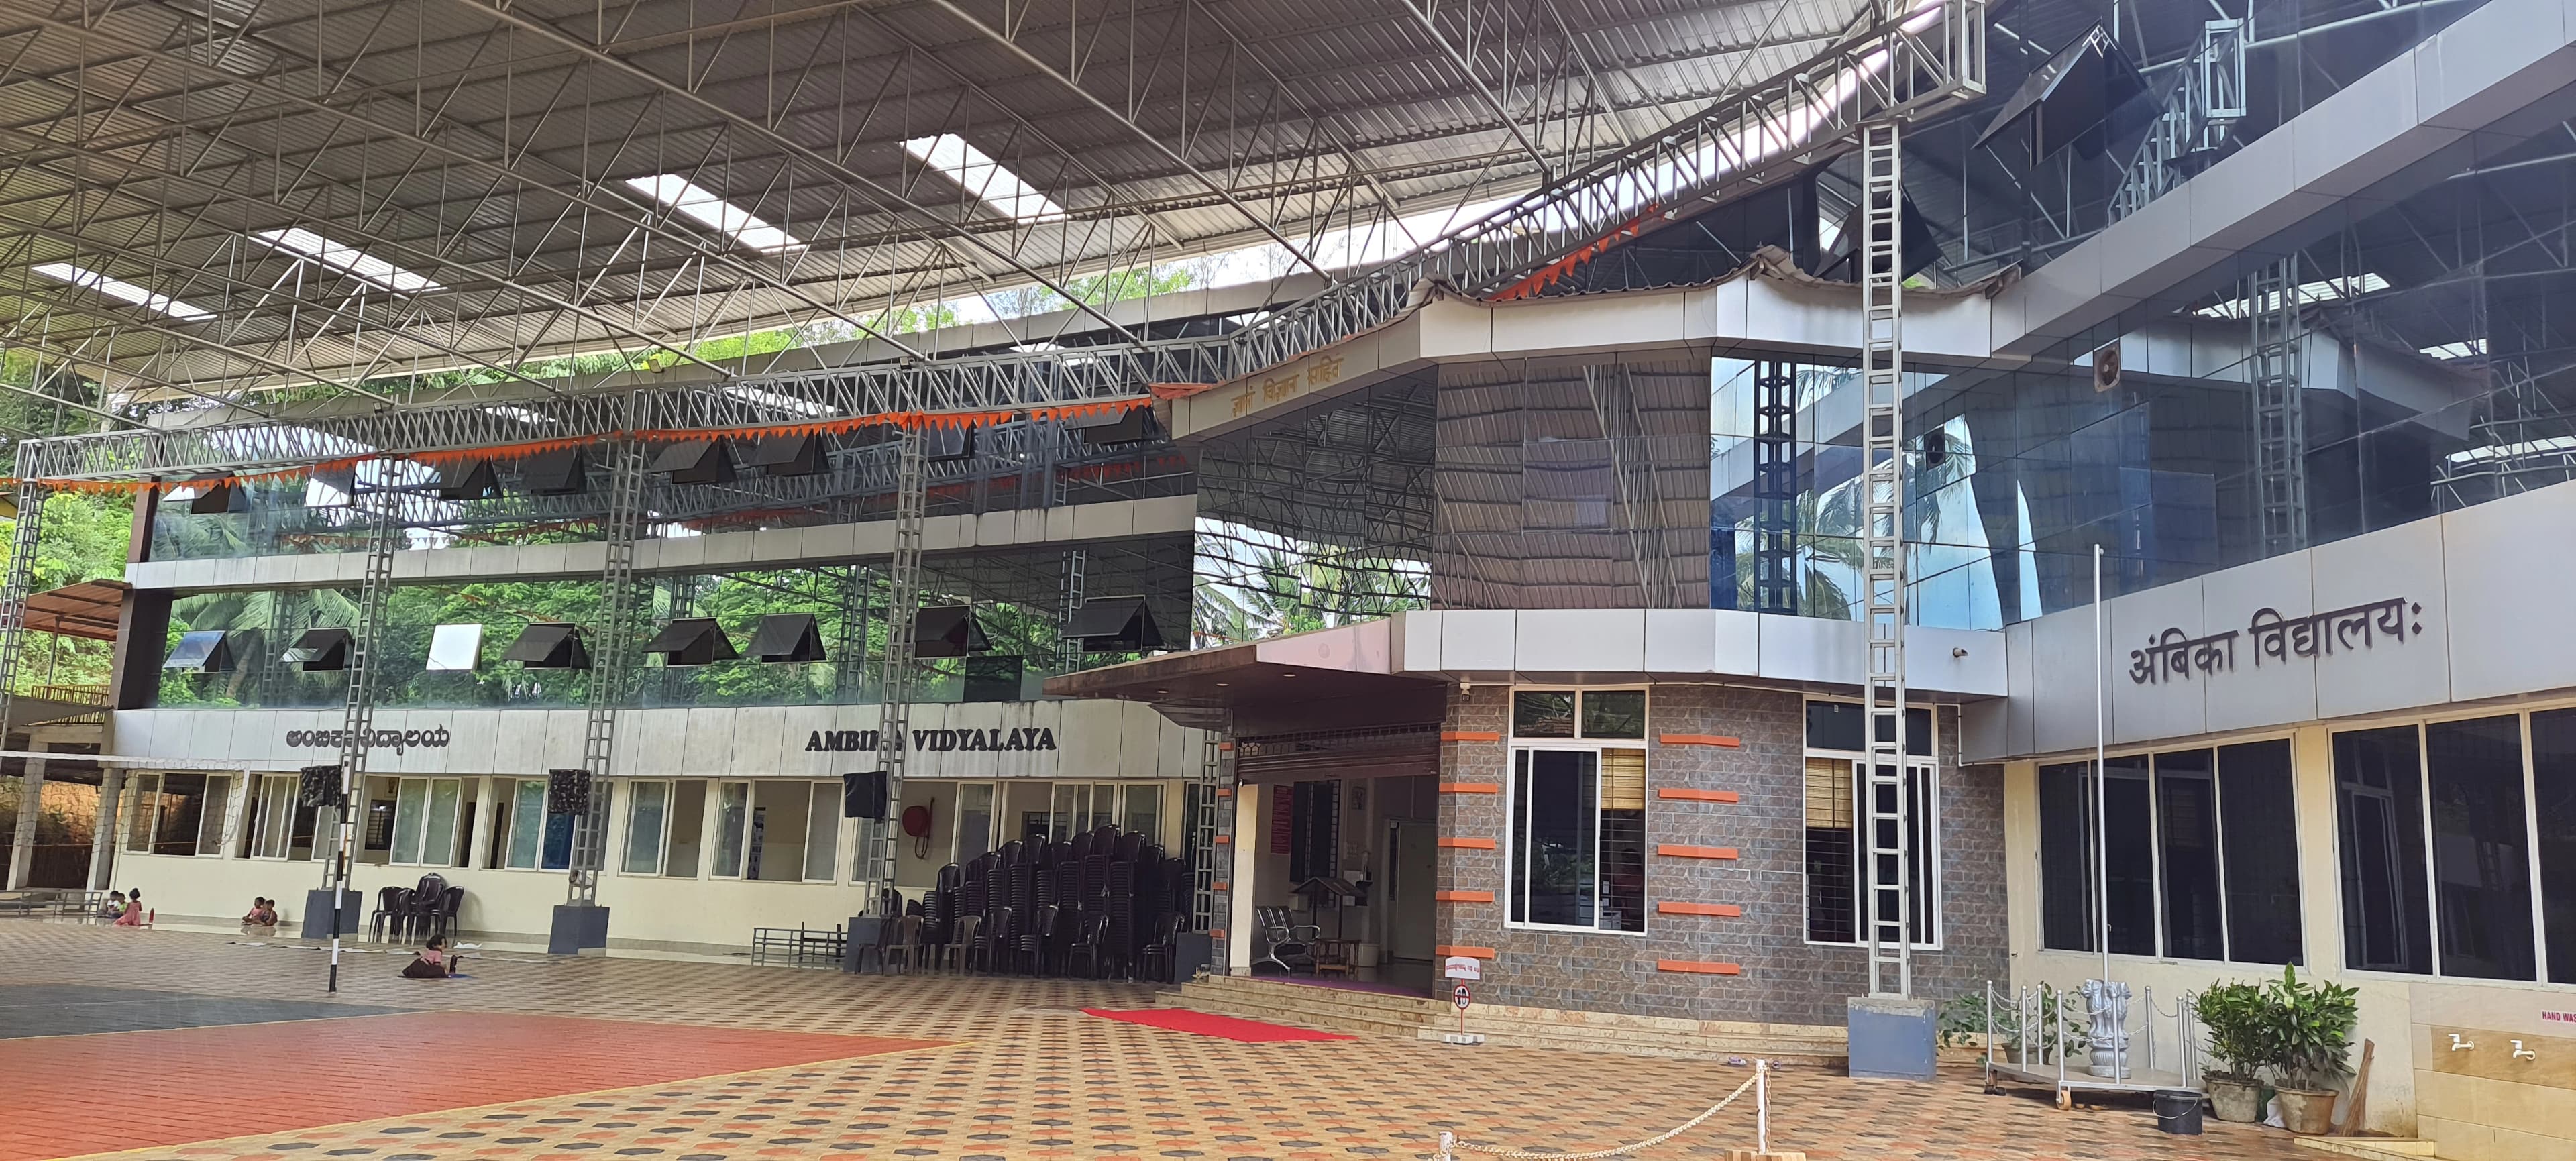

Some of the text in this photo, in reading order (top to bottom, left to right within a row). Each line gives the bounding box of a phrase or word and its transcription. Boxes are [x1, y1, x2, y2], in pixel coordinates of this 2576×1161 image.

[2129, 627, 2240, 685] अंबिका
[912, 727, 1057, 752] VIDYALAYA
[2542, 1011, 2561, 1021] HAND
